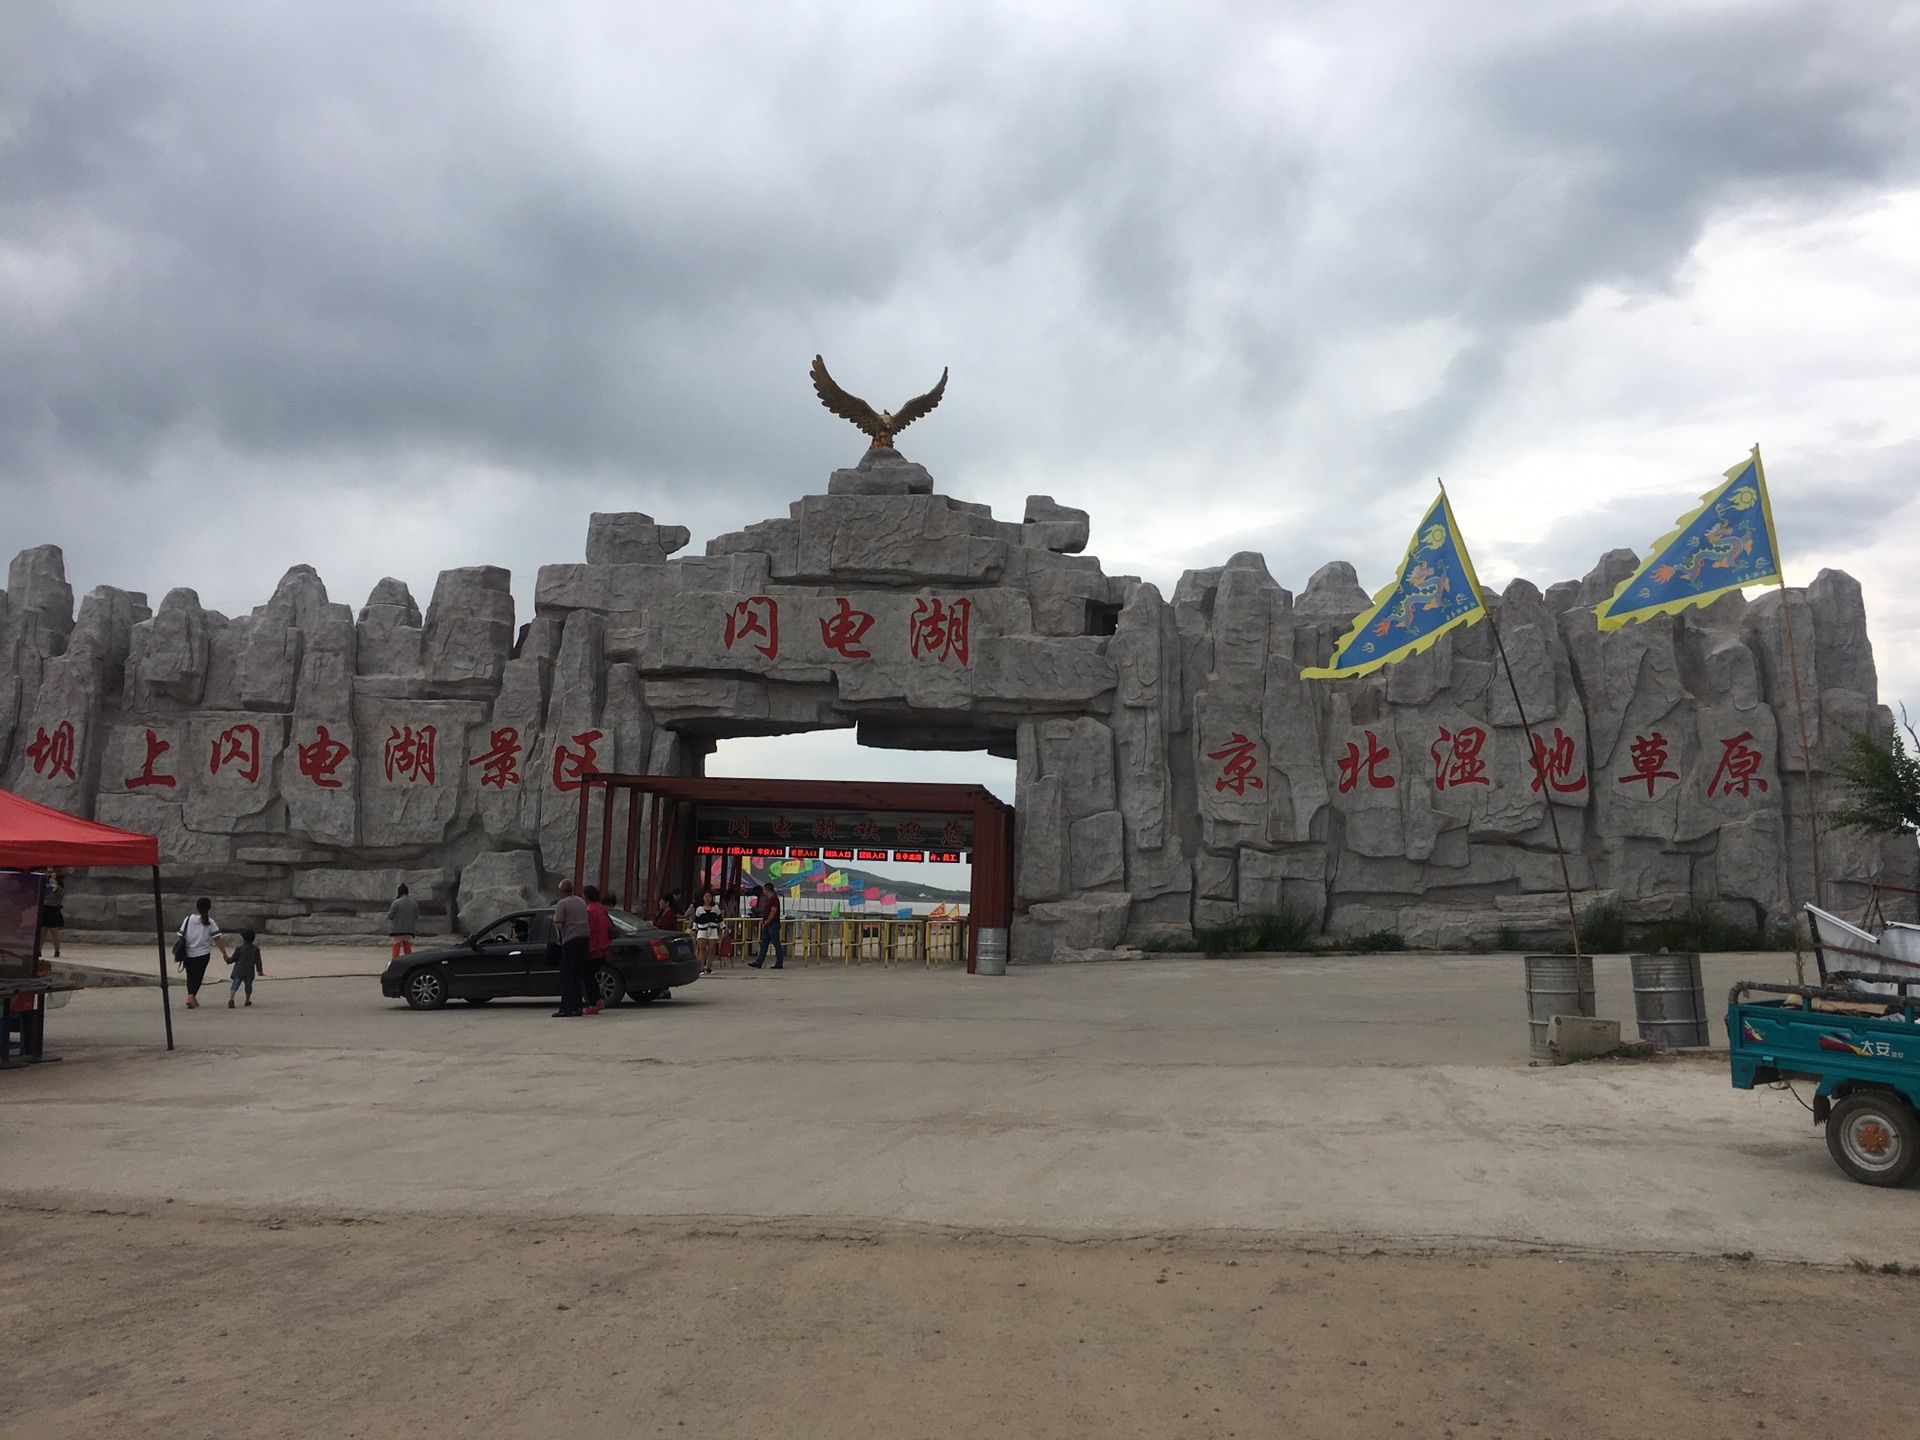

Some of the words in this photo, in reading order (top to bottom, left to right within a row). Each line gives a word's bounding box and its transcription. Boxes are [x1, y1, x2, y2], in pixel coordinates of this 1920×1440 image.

[724, 597, 971, 665] 闪电湖
[27, 720, 607, 791] 坝上闪电湖景区
[1208, 726, 1767, 798] 京北湿地草原
[1860, 1040, 1891, 1057] 大安
